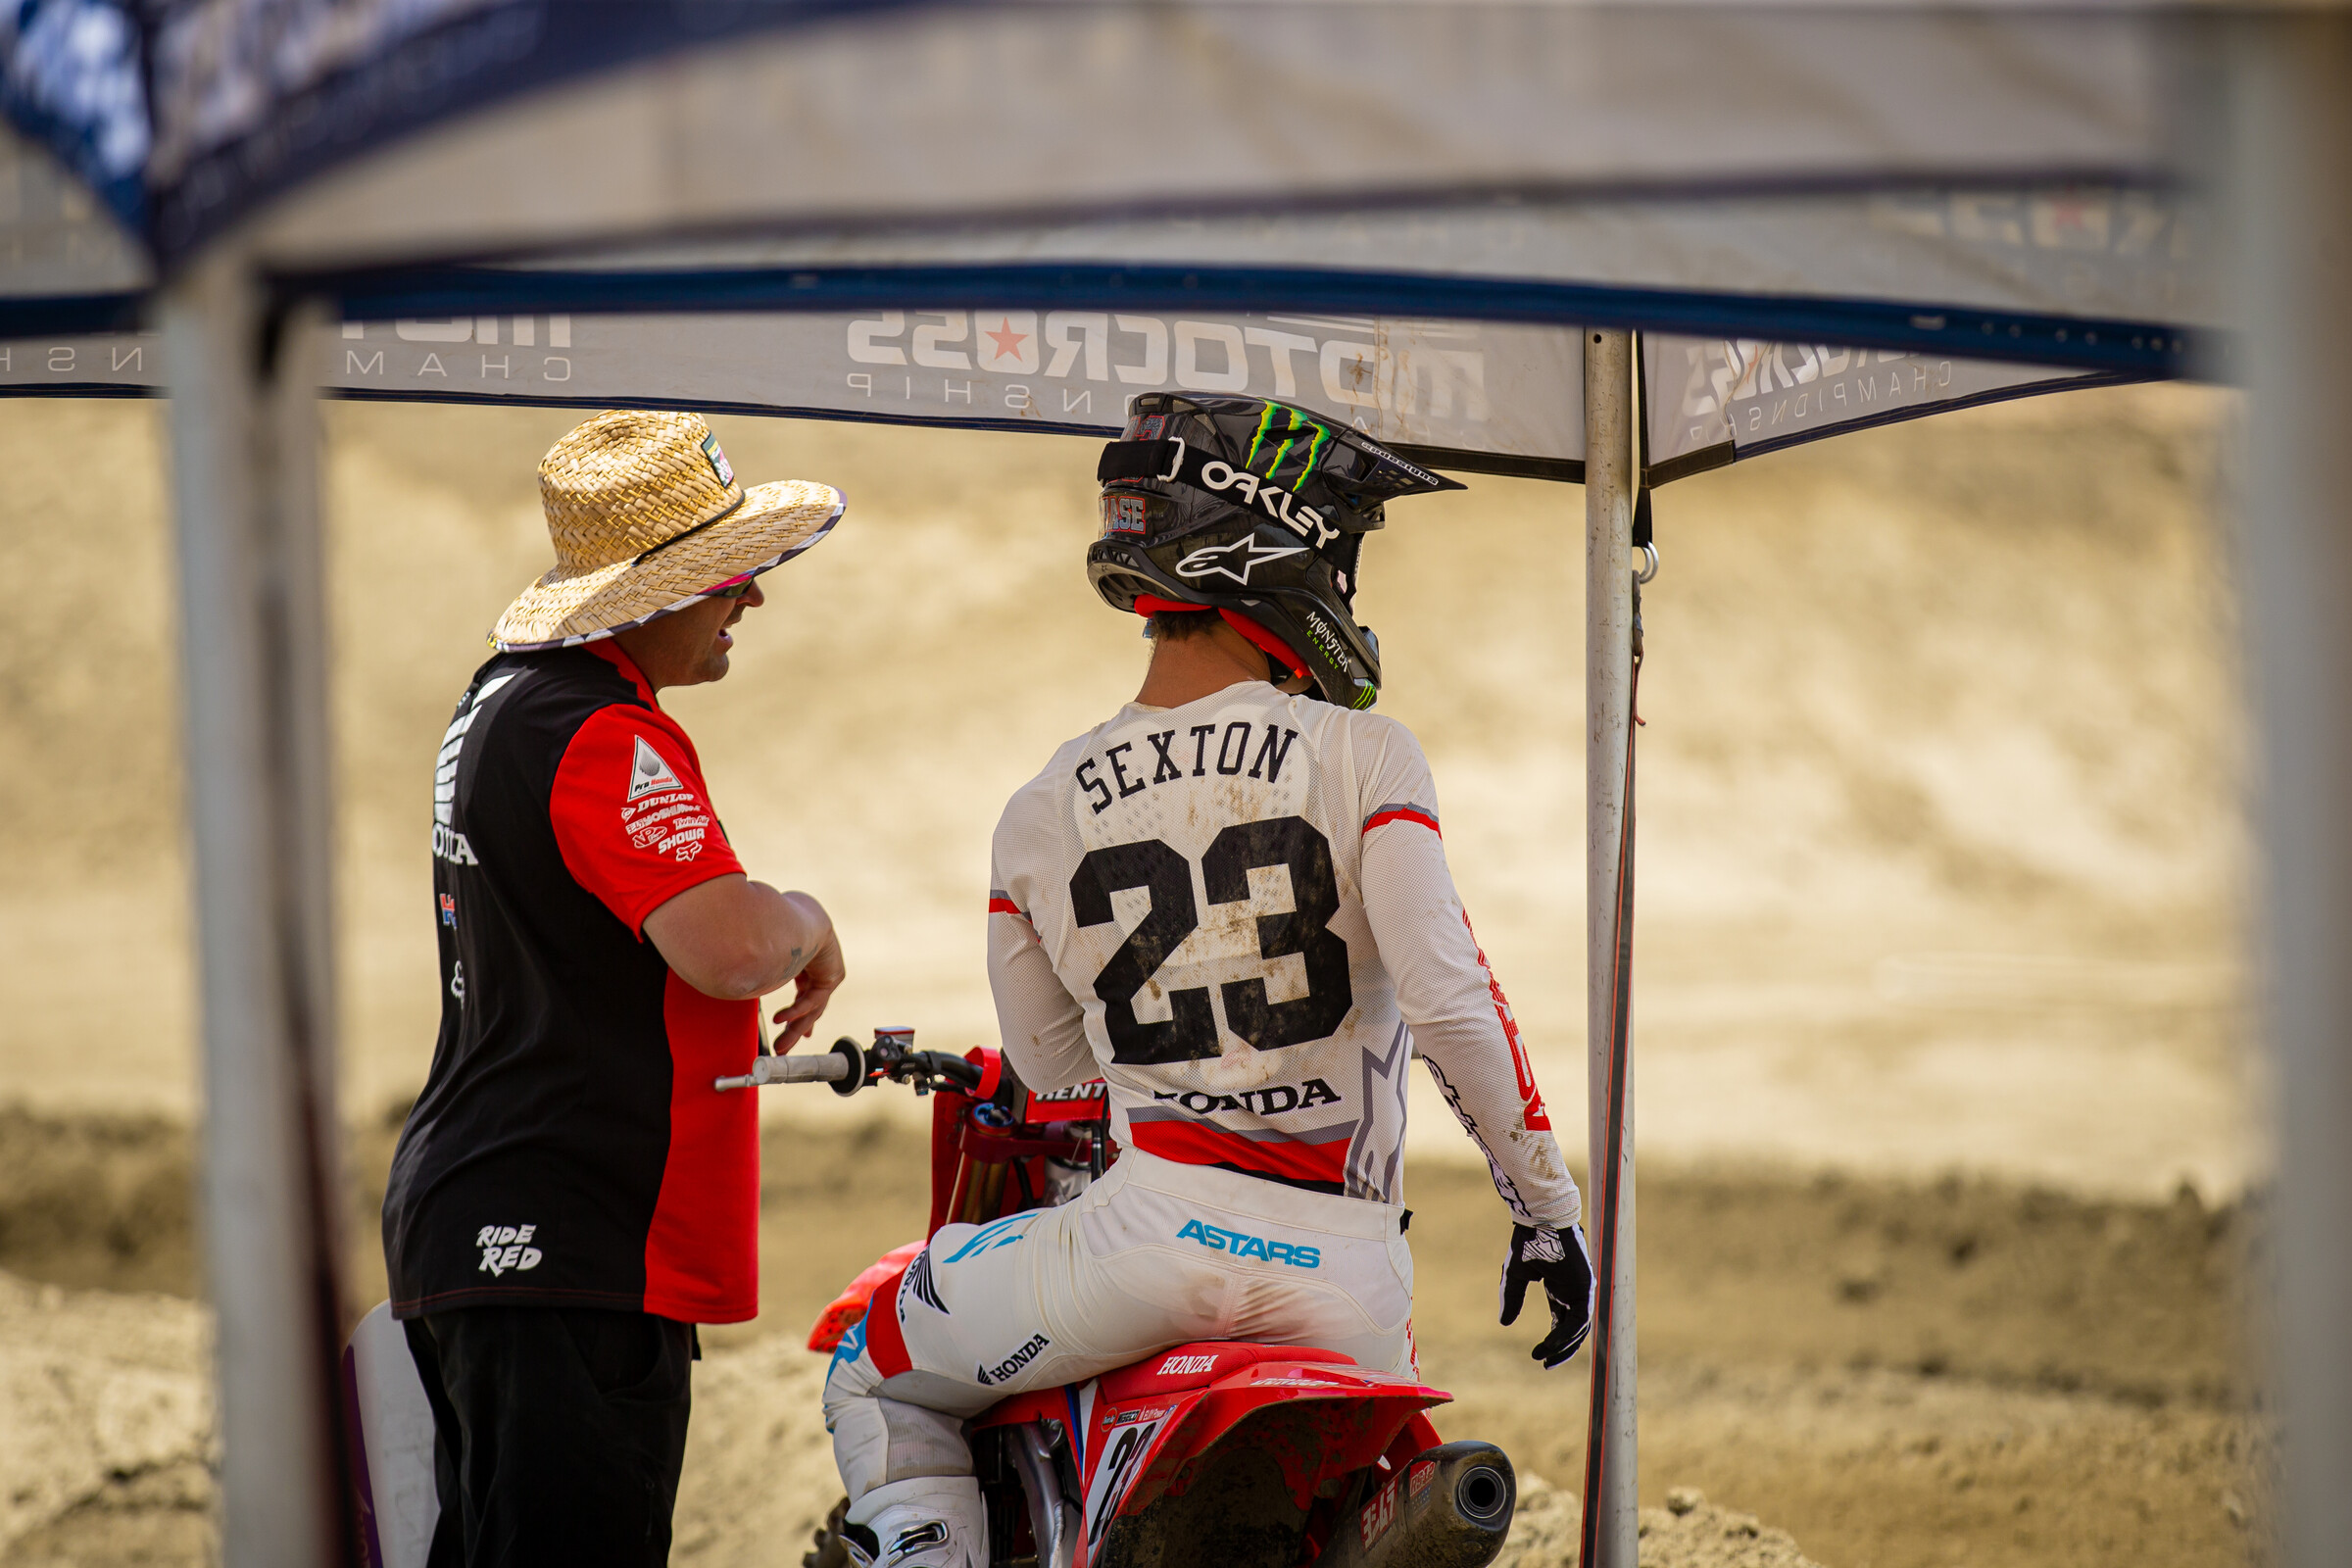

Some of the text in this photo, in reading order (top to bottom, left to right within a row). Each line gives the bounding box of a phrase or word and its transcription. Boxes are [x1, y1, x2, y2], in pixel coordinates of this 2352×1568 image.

[1200, 461, 1340, 549] OAKLEY
[1306, 630, 1339, 669] ENERGY
[1075, 721, 1298, 815] SEXTON
[637, 793, 695, 813] DUNLOP
[659, 828, 706, 856] SHOWA
[1068, 815, 1353, 1065] 23
[475, 1223, 537, 1249] RIDE
[1176, 1218, 1321, 1269] ASTARS
[478, 1245, 543, 1278] RED
[989, 1333, 1051, 1382] HONDA
[1156, 1354, 1219, 1376] HONDA
